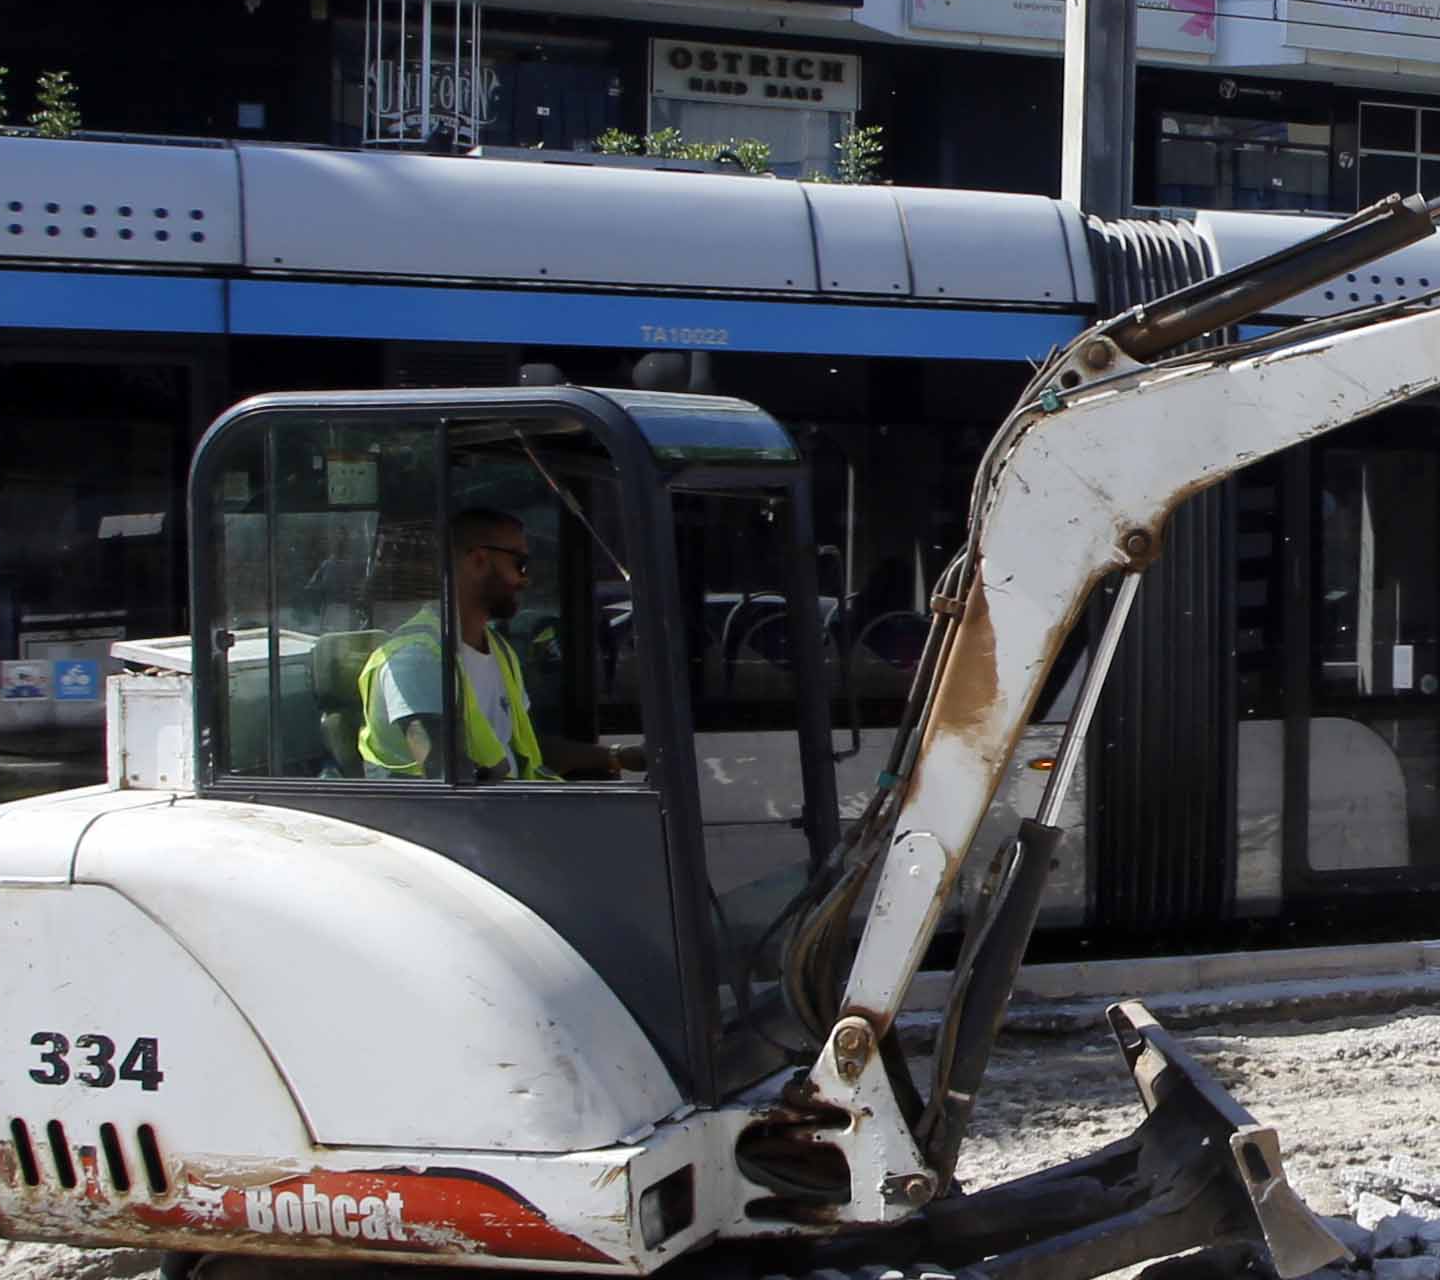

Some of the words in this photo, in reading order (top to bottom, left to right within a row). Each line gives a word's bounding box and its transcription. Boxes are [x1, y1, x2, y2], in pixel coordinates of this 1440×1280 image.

[668, 46, 845, 84] OSTRICH
[687, 76, 749, 96] HAND
[763, 82, 824, 103] BAGS
[28, 1031, 164, 1092] 334
[245, 1183, 408, 1242] Bobcat
